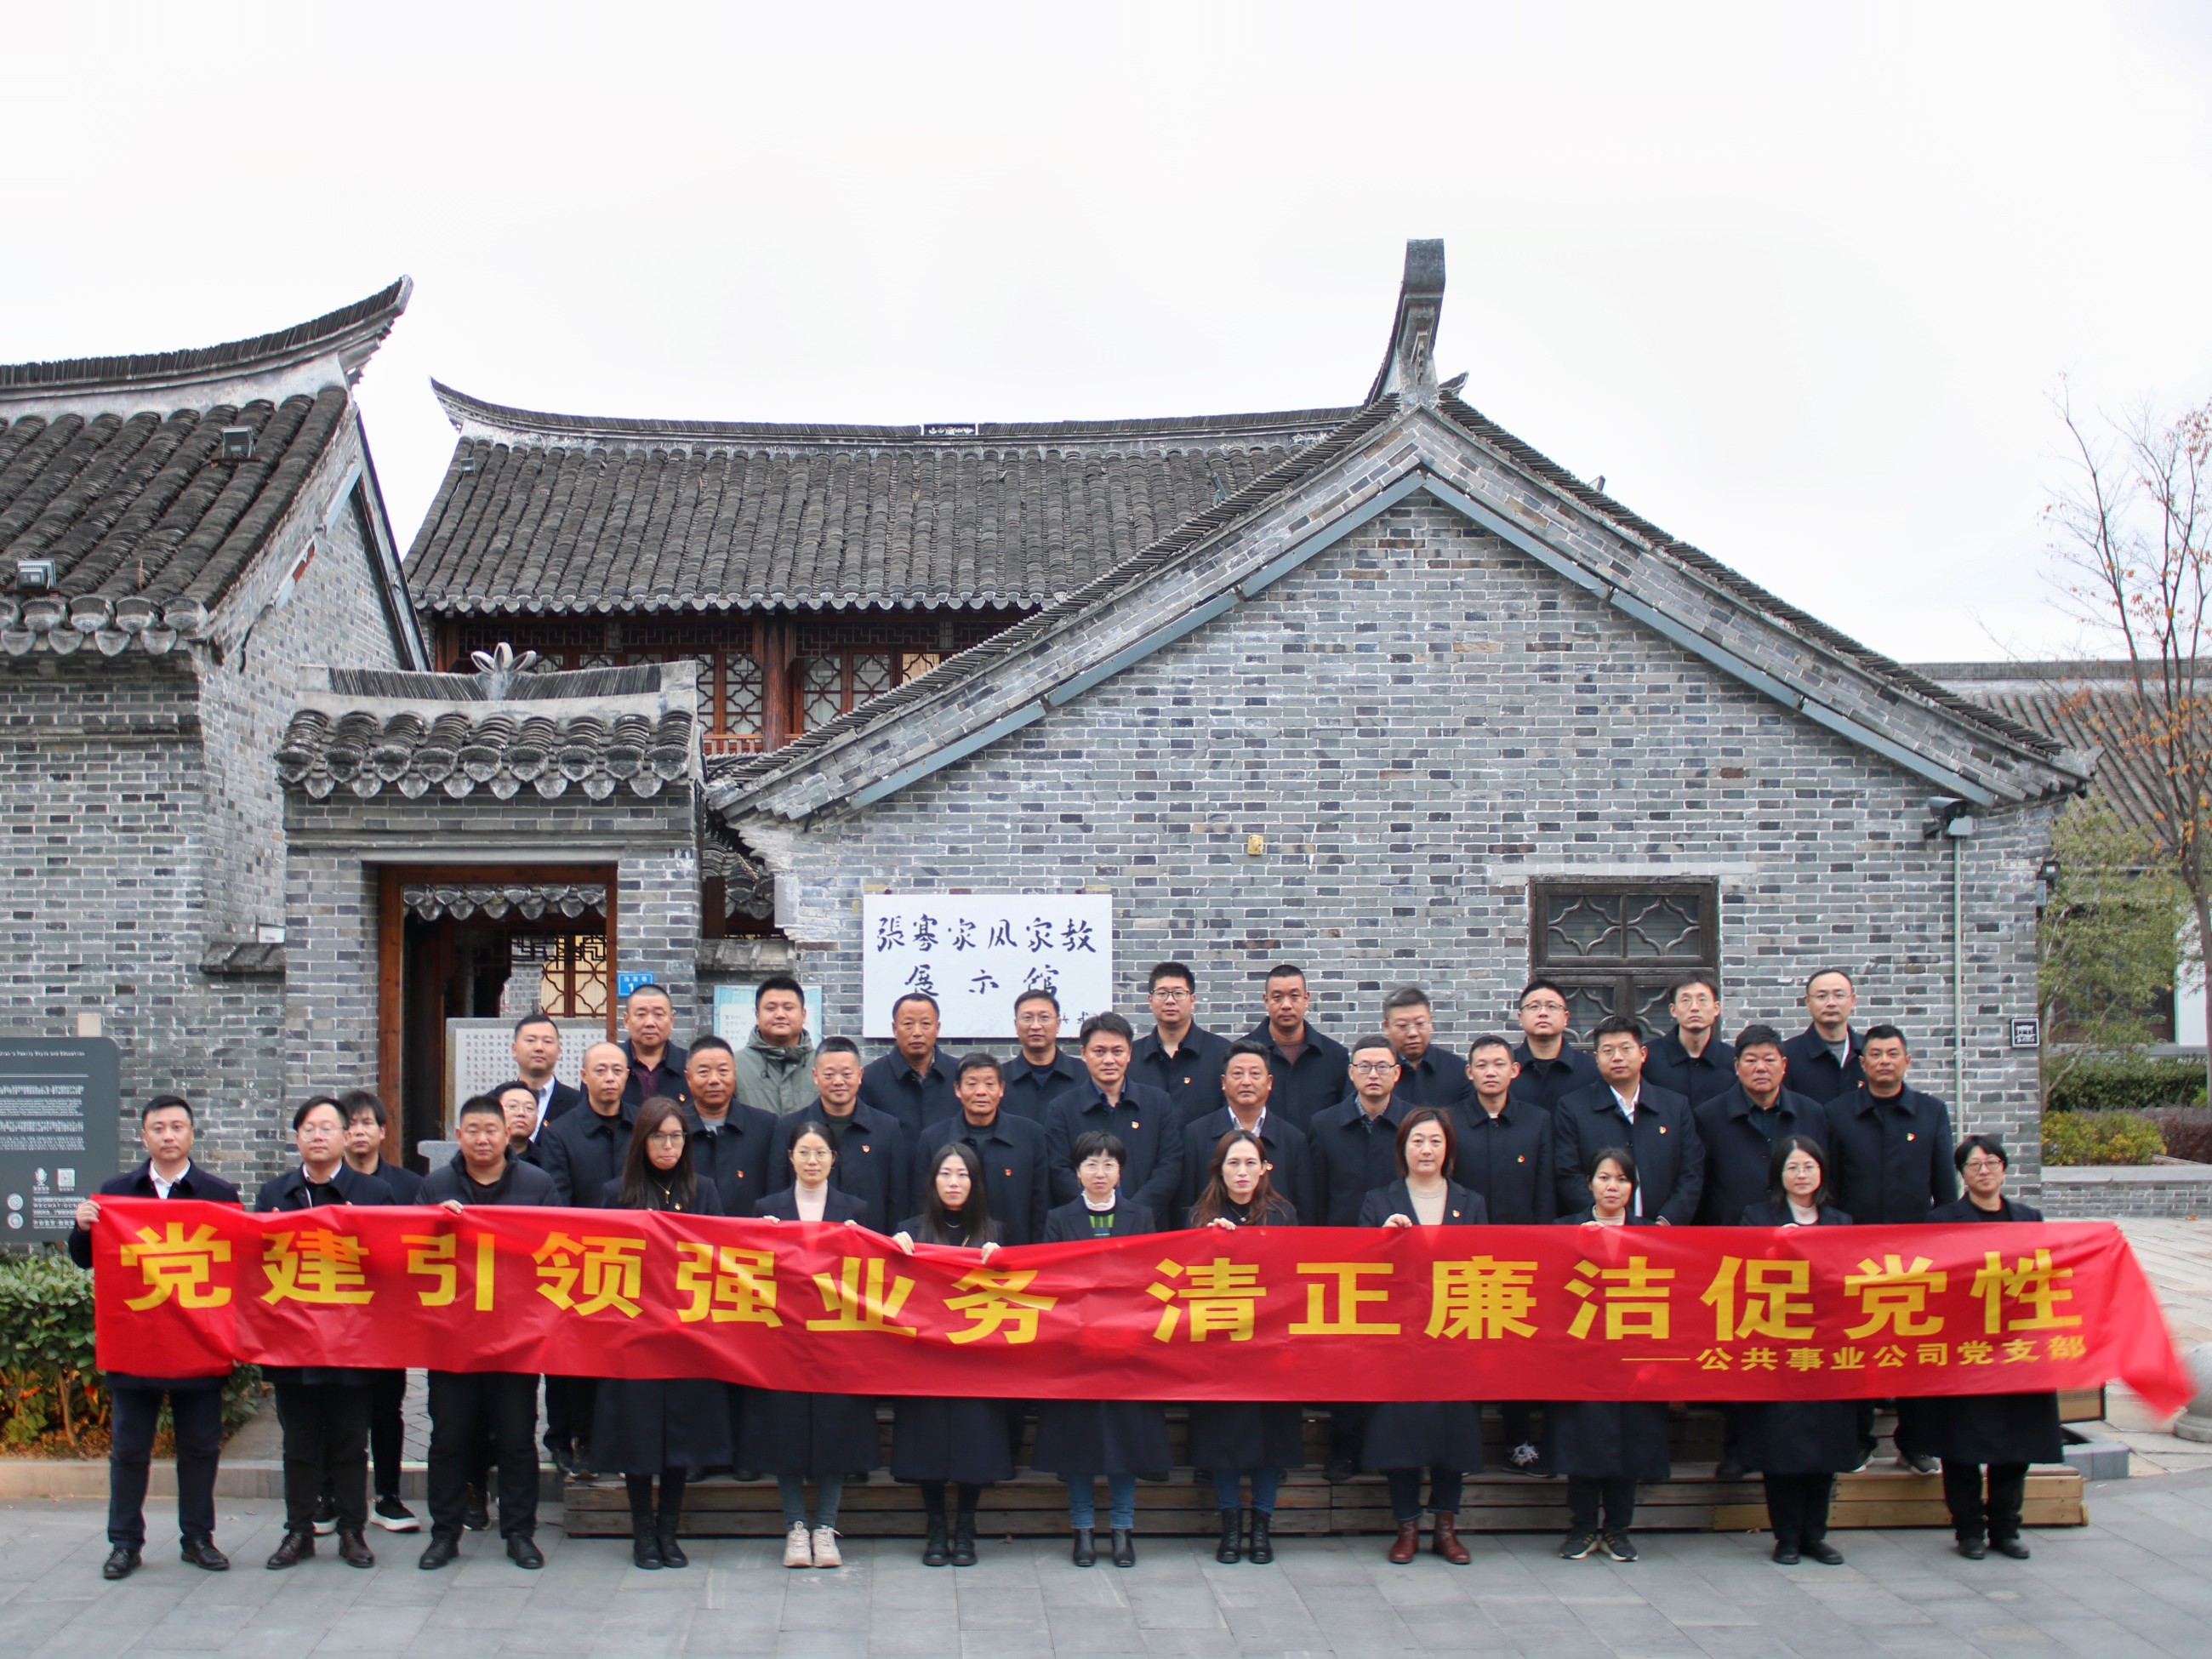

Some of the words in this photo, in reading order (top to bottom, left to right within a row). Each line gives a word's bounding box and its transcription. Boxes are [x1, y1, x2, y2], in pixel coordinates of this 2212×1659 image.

[118, 1222, 1058, 1345] 党建引领强业务
[1145, 1248, 2084, 1342] 清正廉洁促党性
